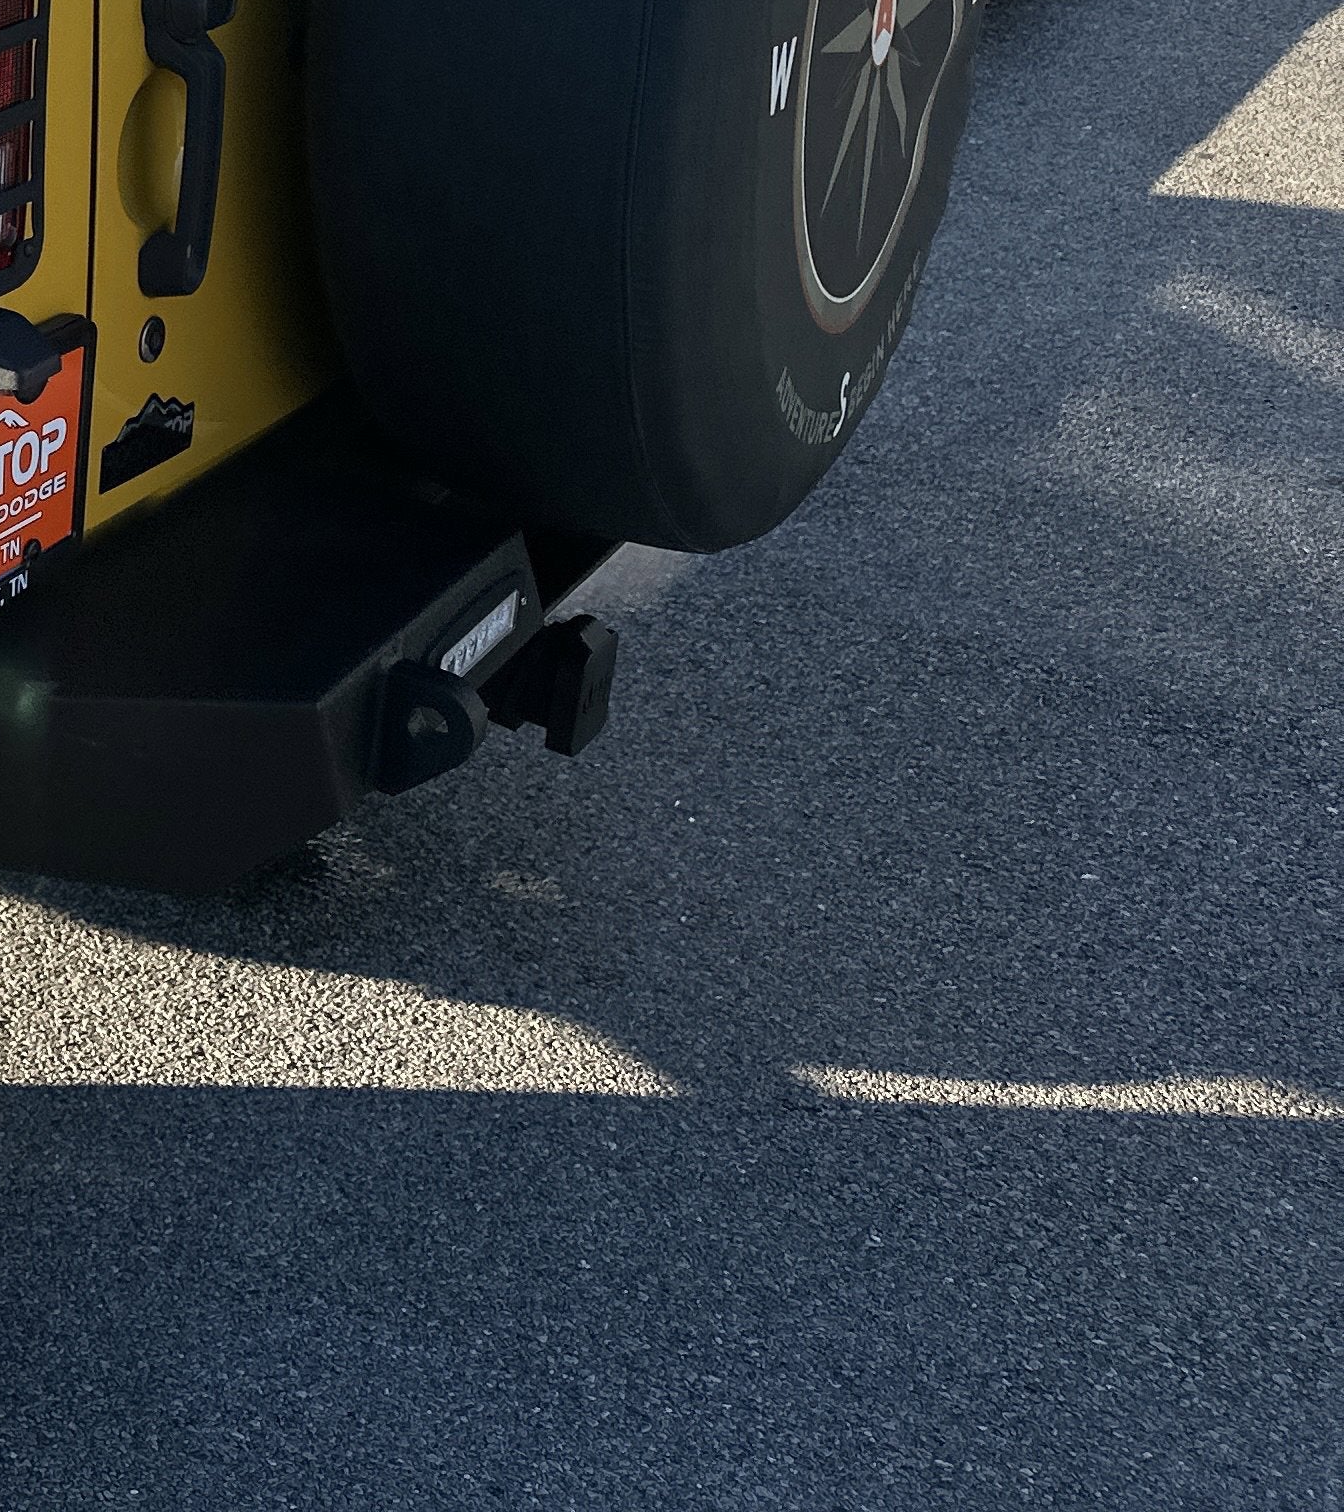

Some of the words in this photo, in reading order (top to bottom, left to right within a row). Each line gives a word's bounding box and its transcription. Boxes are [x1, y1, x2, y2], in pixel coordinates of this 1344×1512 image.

[769, 36, 798, 117] W
[0, 537, 22, 564] TN
[9, 570, 29, 597] TN
